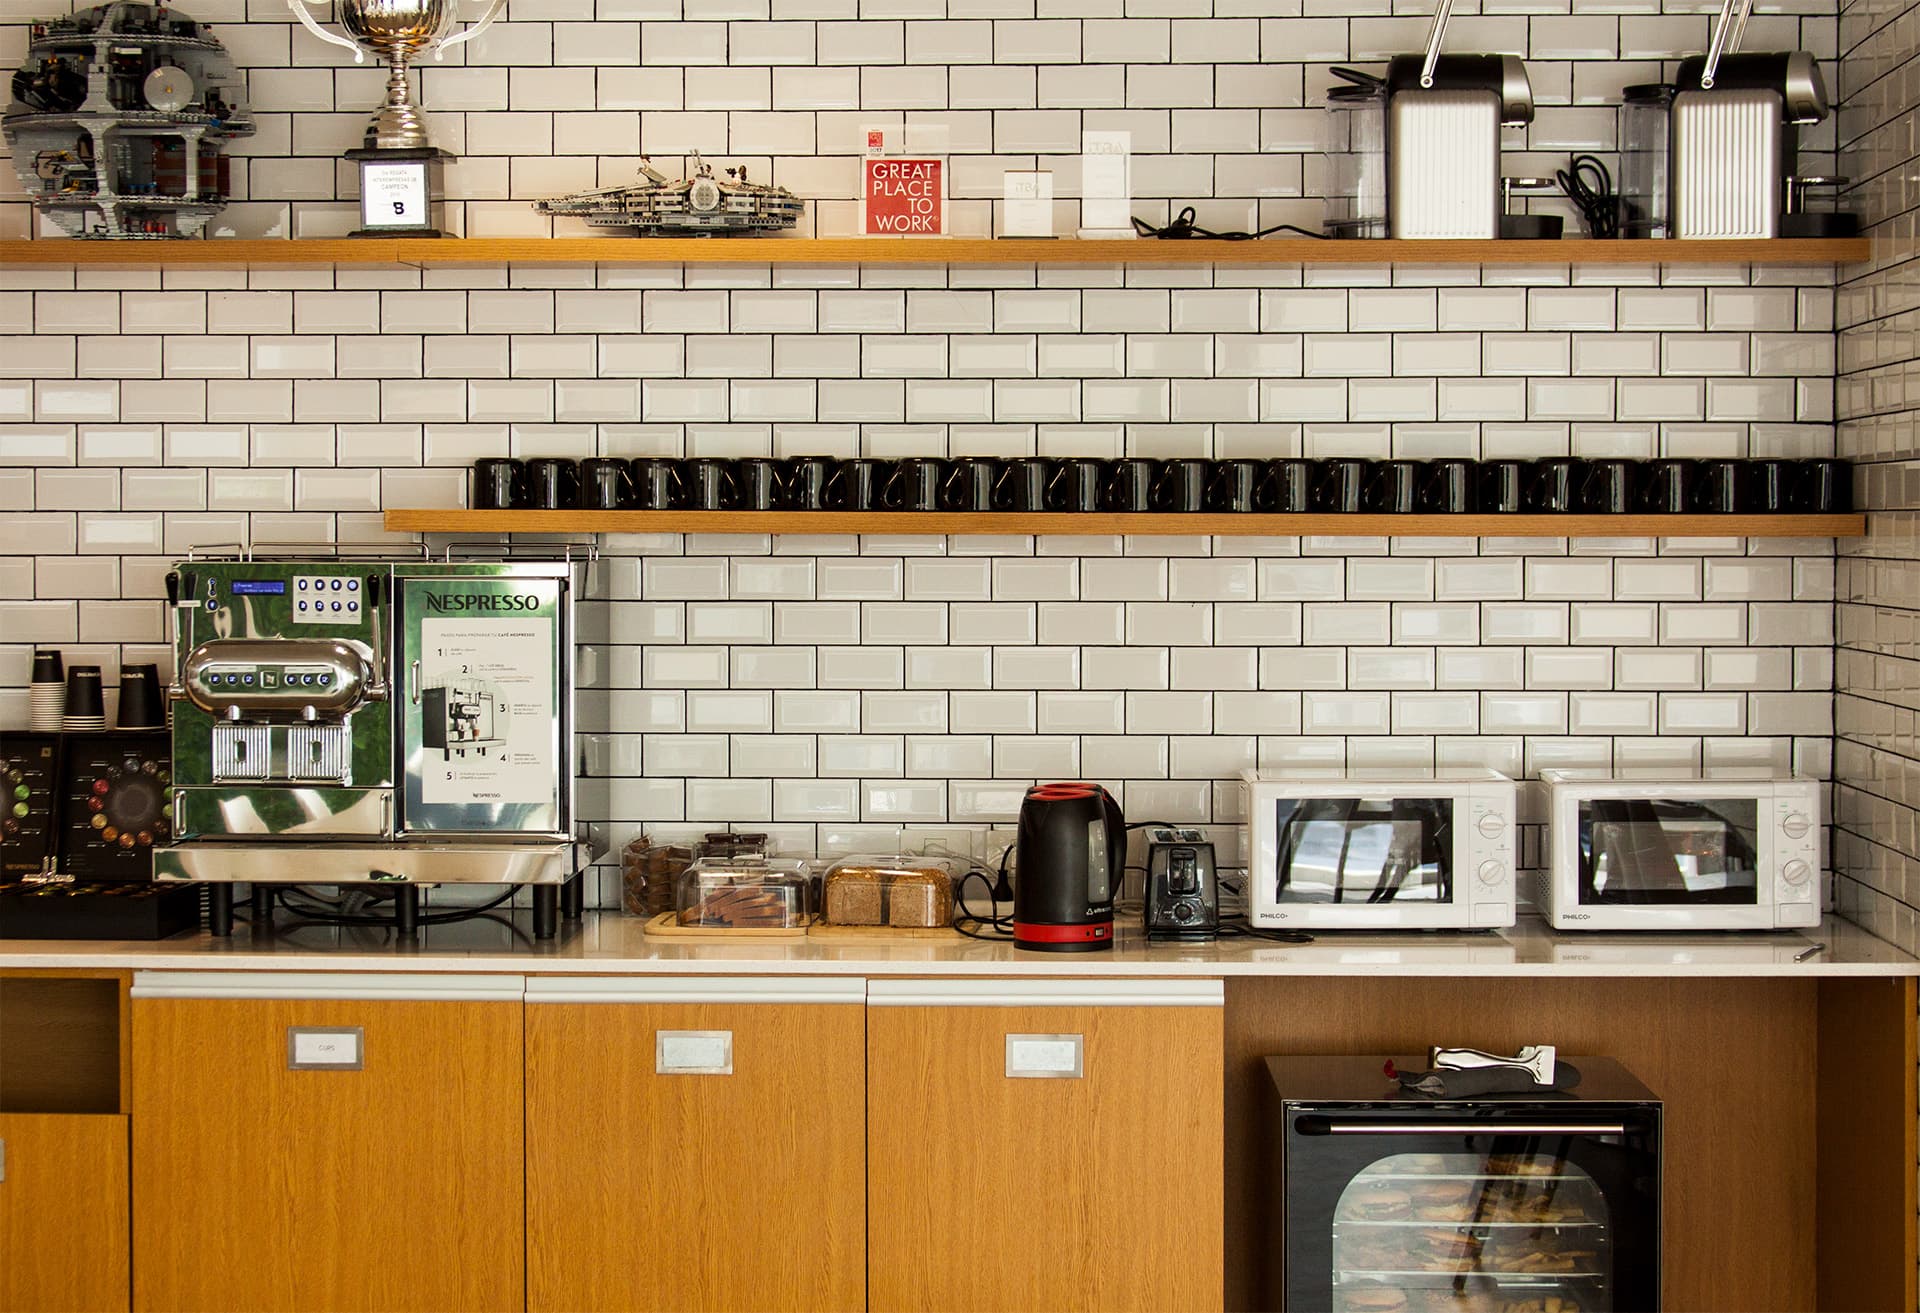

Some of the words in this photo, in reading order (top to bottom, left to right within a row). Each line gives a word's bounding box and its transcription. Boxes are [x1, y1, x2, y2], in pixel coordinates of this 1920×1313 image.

[872, 163, 935, 179] GREAT
[873, 180, 933, 196] PLACE
[907, 197, 934, 214] TO
[875, 214, 934, 232] WORK
[423, 590, 540, 614] NESPRESSO
[437, 648, 442, 657] 1
[462, 664, 468, 674] 2
[499, 703, 506, 713] 3
[499, 753, 506, 762] 4
[446, 771, 453, 780] 5
